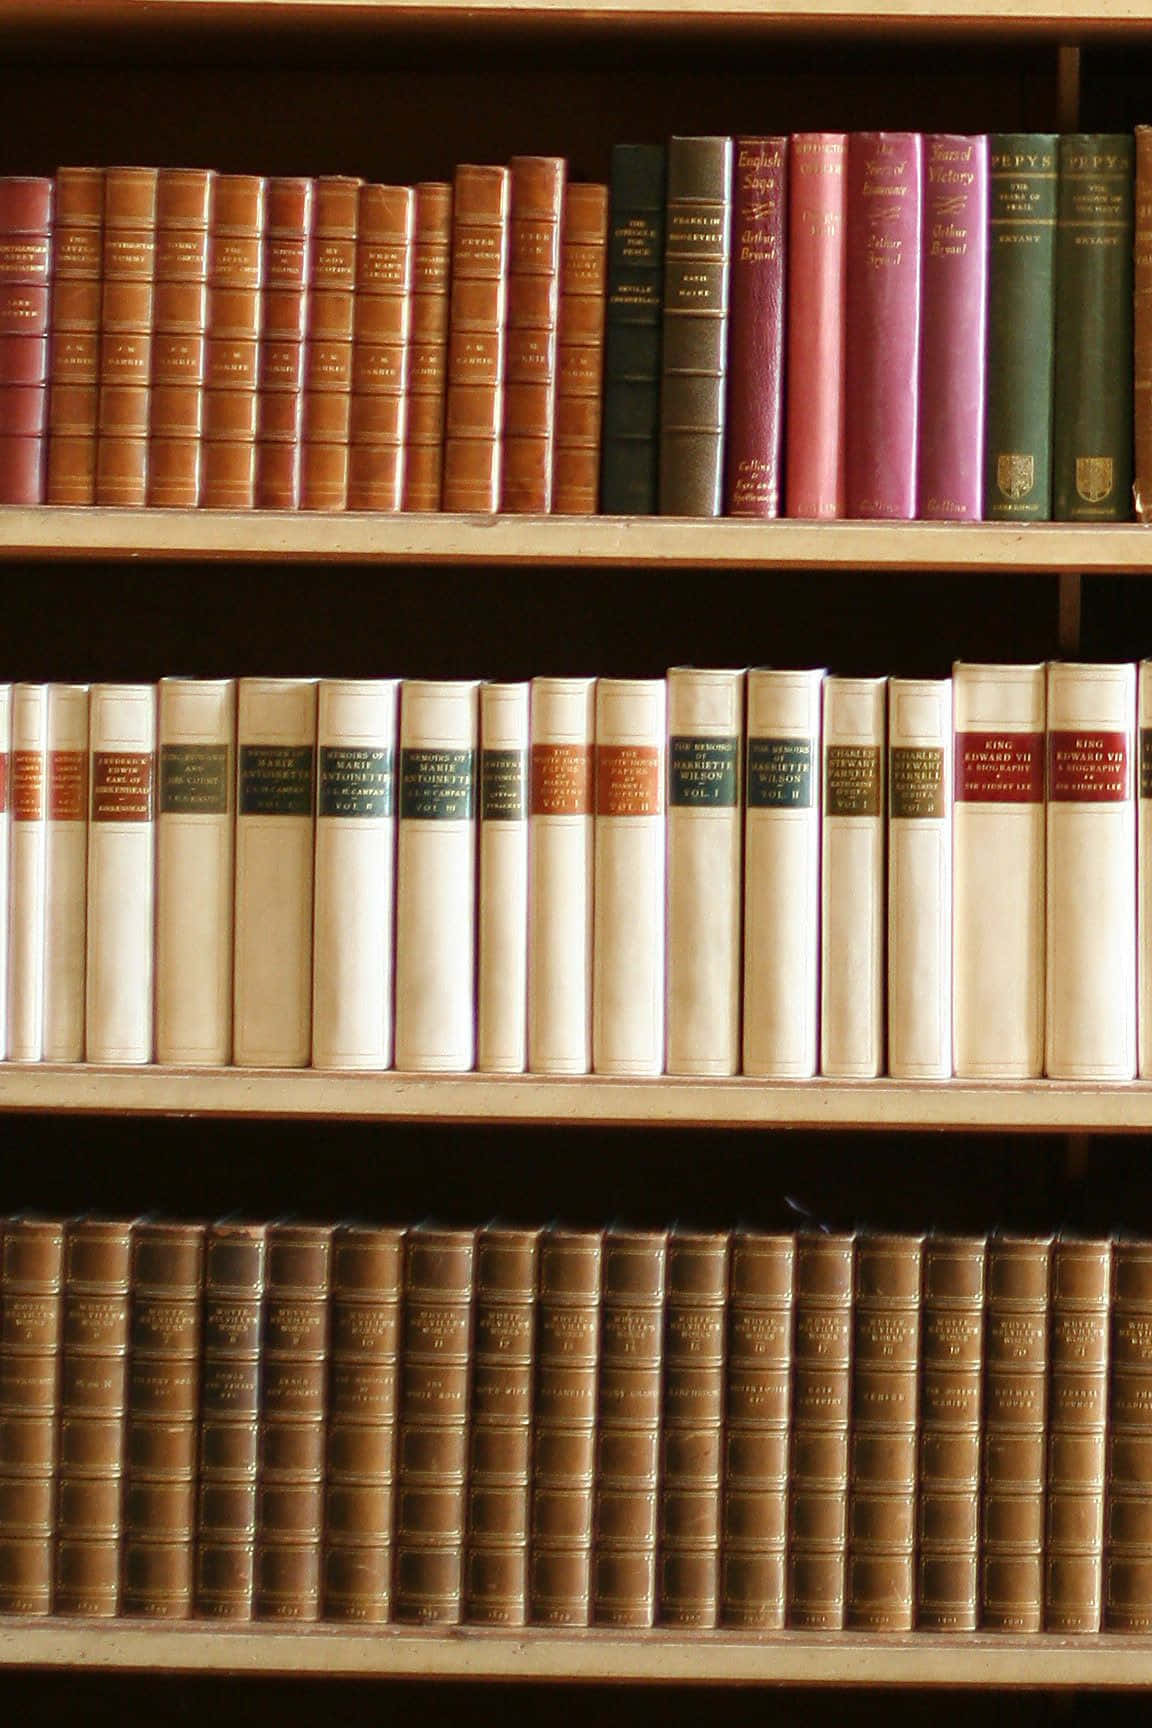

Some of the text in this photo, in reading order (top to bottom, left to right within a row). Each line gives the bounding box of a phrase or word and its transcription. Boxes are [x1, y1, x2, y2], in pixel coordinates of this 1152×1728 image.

[930, 143, 973, 162] Years of
[737, 151, 782, 172] English
[991, 155, 1052, 169] PEPYS
[927, 165, 975, 186] Victory
[743, 176, 775, 196] Saga
[931, 224, 969, 239] Arthur
[740, 229, 776, 245] Arthur
[930, 240, 969, 258] Bryant
[740, 248, 777, 265] Bryant
[984, 740, 1014, 750] KING
[1075, 739, 1105, 749] KING
[964, 752, 1033, 762] EDWARD VII
[1056, 752, 1124, 761] EDWARD VII
[335, 760, 372, 770] MARIE
[418, 762, 457, 772] MARIE
[672, 761, 733, 771] HARRIETTE
[750, 762, 809, 772] HARRIETTE
[976, 764, 1032, 772] BIOGRAPHY
[1066, 764, 1122, 772] BIOGRAPHY
[680, 770, 724, 781] WILSON
[758, 773, 802, 784] WILSON
[1106, 783, 1123, 791] LEE
